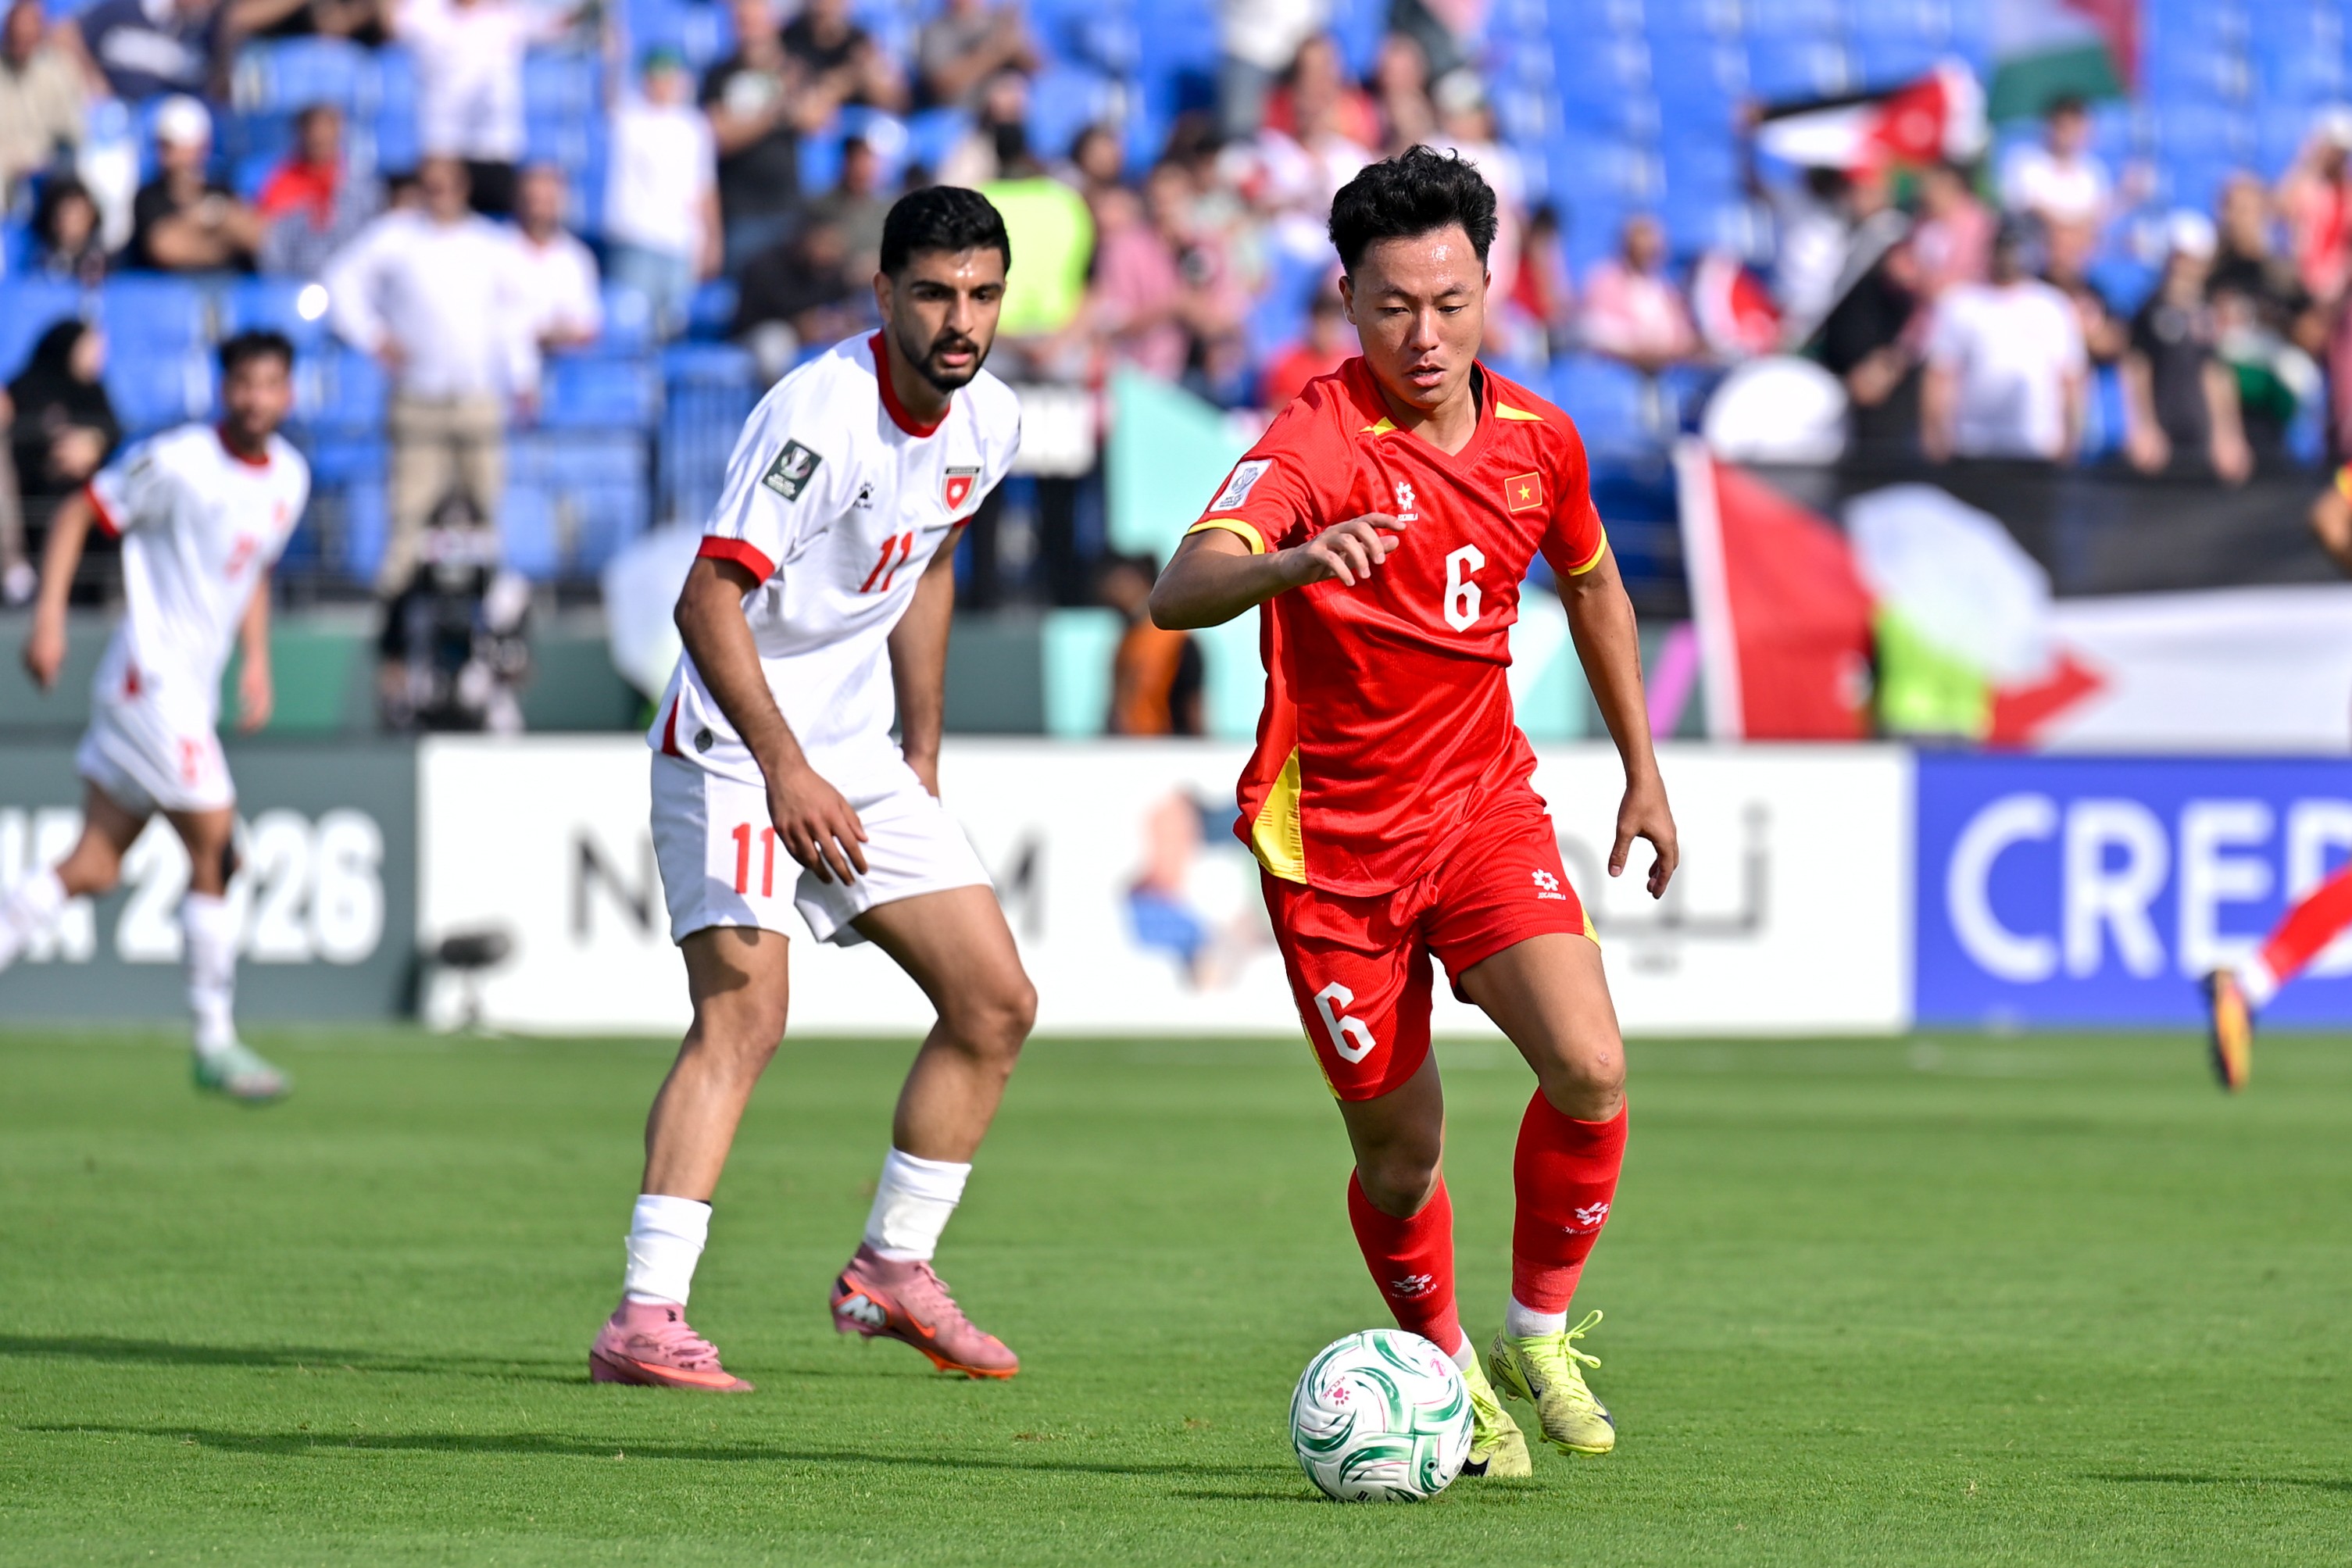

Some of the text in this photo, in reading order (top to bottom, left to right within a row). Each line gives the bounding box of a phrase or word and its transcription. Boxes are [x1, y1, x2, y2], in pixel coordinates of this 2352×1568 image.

[859, 531, 913, 593] 11
[1442, 543, 1485, 634] 6
[115, 806, 385, 963] 226
[732, 822, 776, 898] 11
[1314, 980, 1377, 1064] 6
